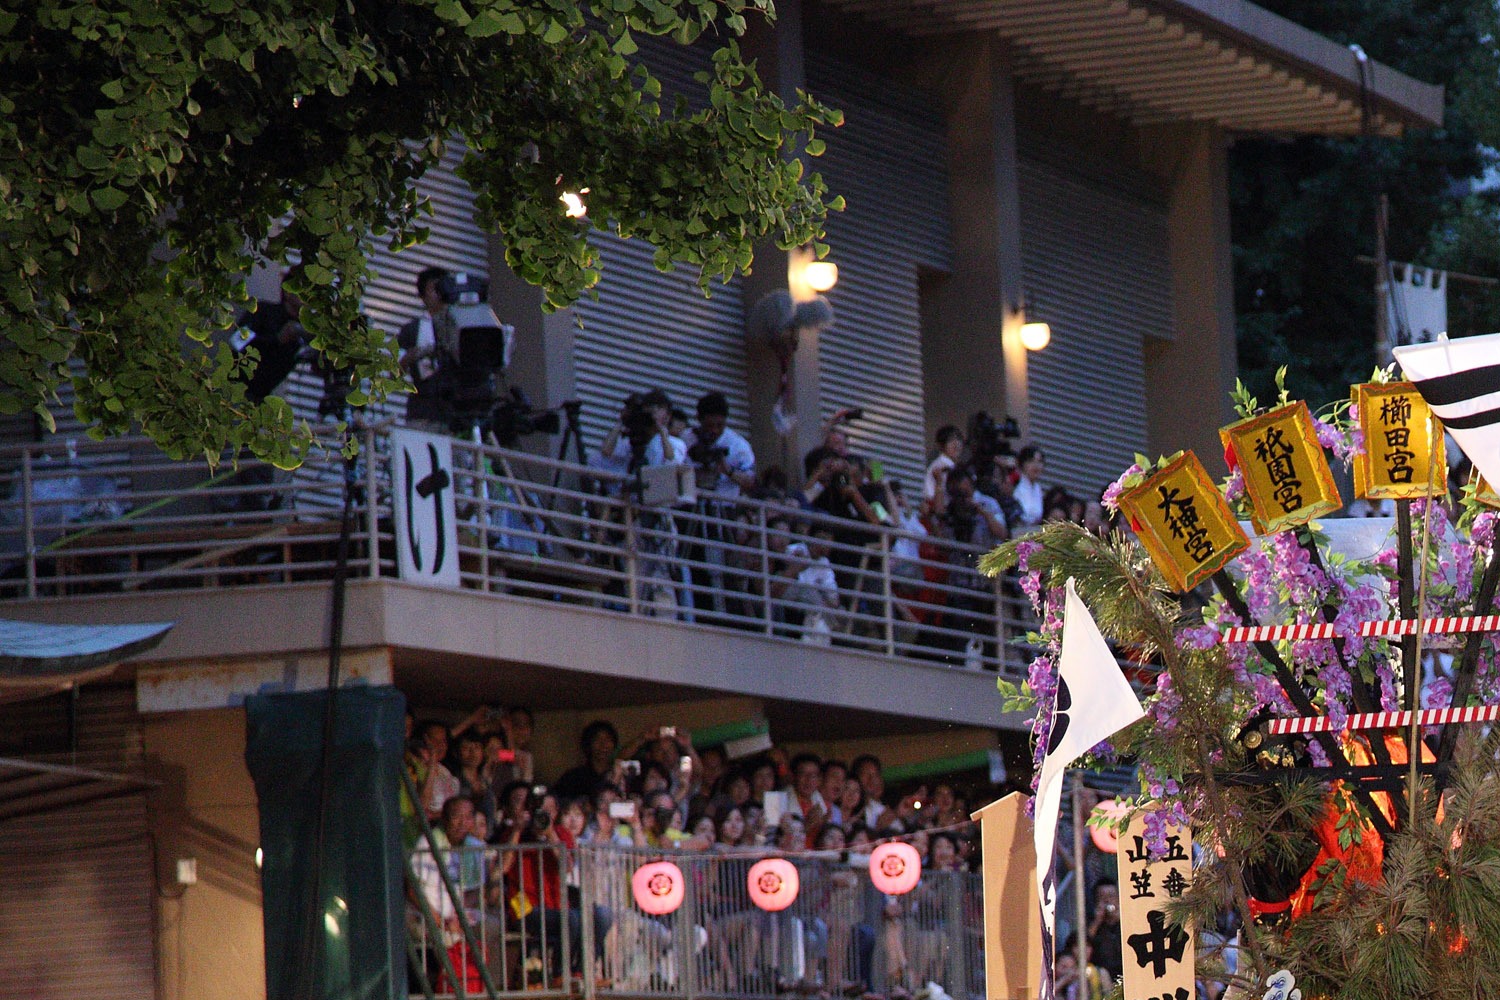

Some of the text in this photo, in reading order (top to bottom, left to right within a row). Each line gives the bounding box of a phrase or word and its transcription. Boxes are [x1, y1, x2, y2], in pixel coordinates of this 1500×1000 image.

[1379, 395, 1416, 484] 櫛田宮
[403, 441, 451, 575] け
[1157, 485, 1216, 563] 大神宮
